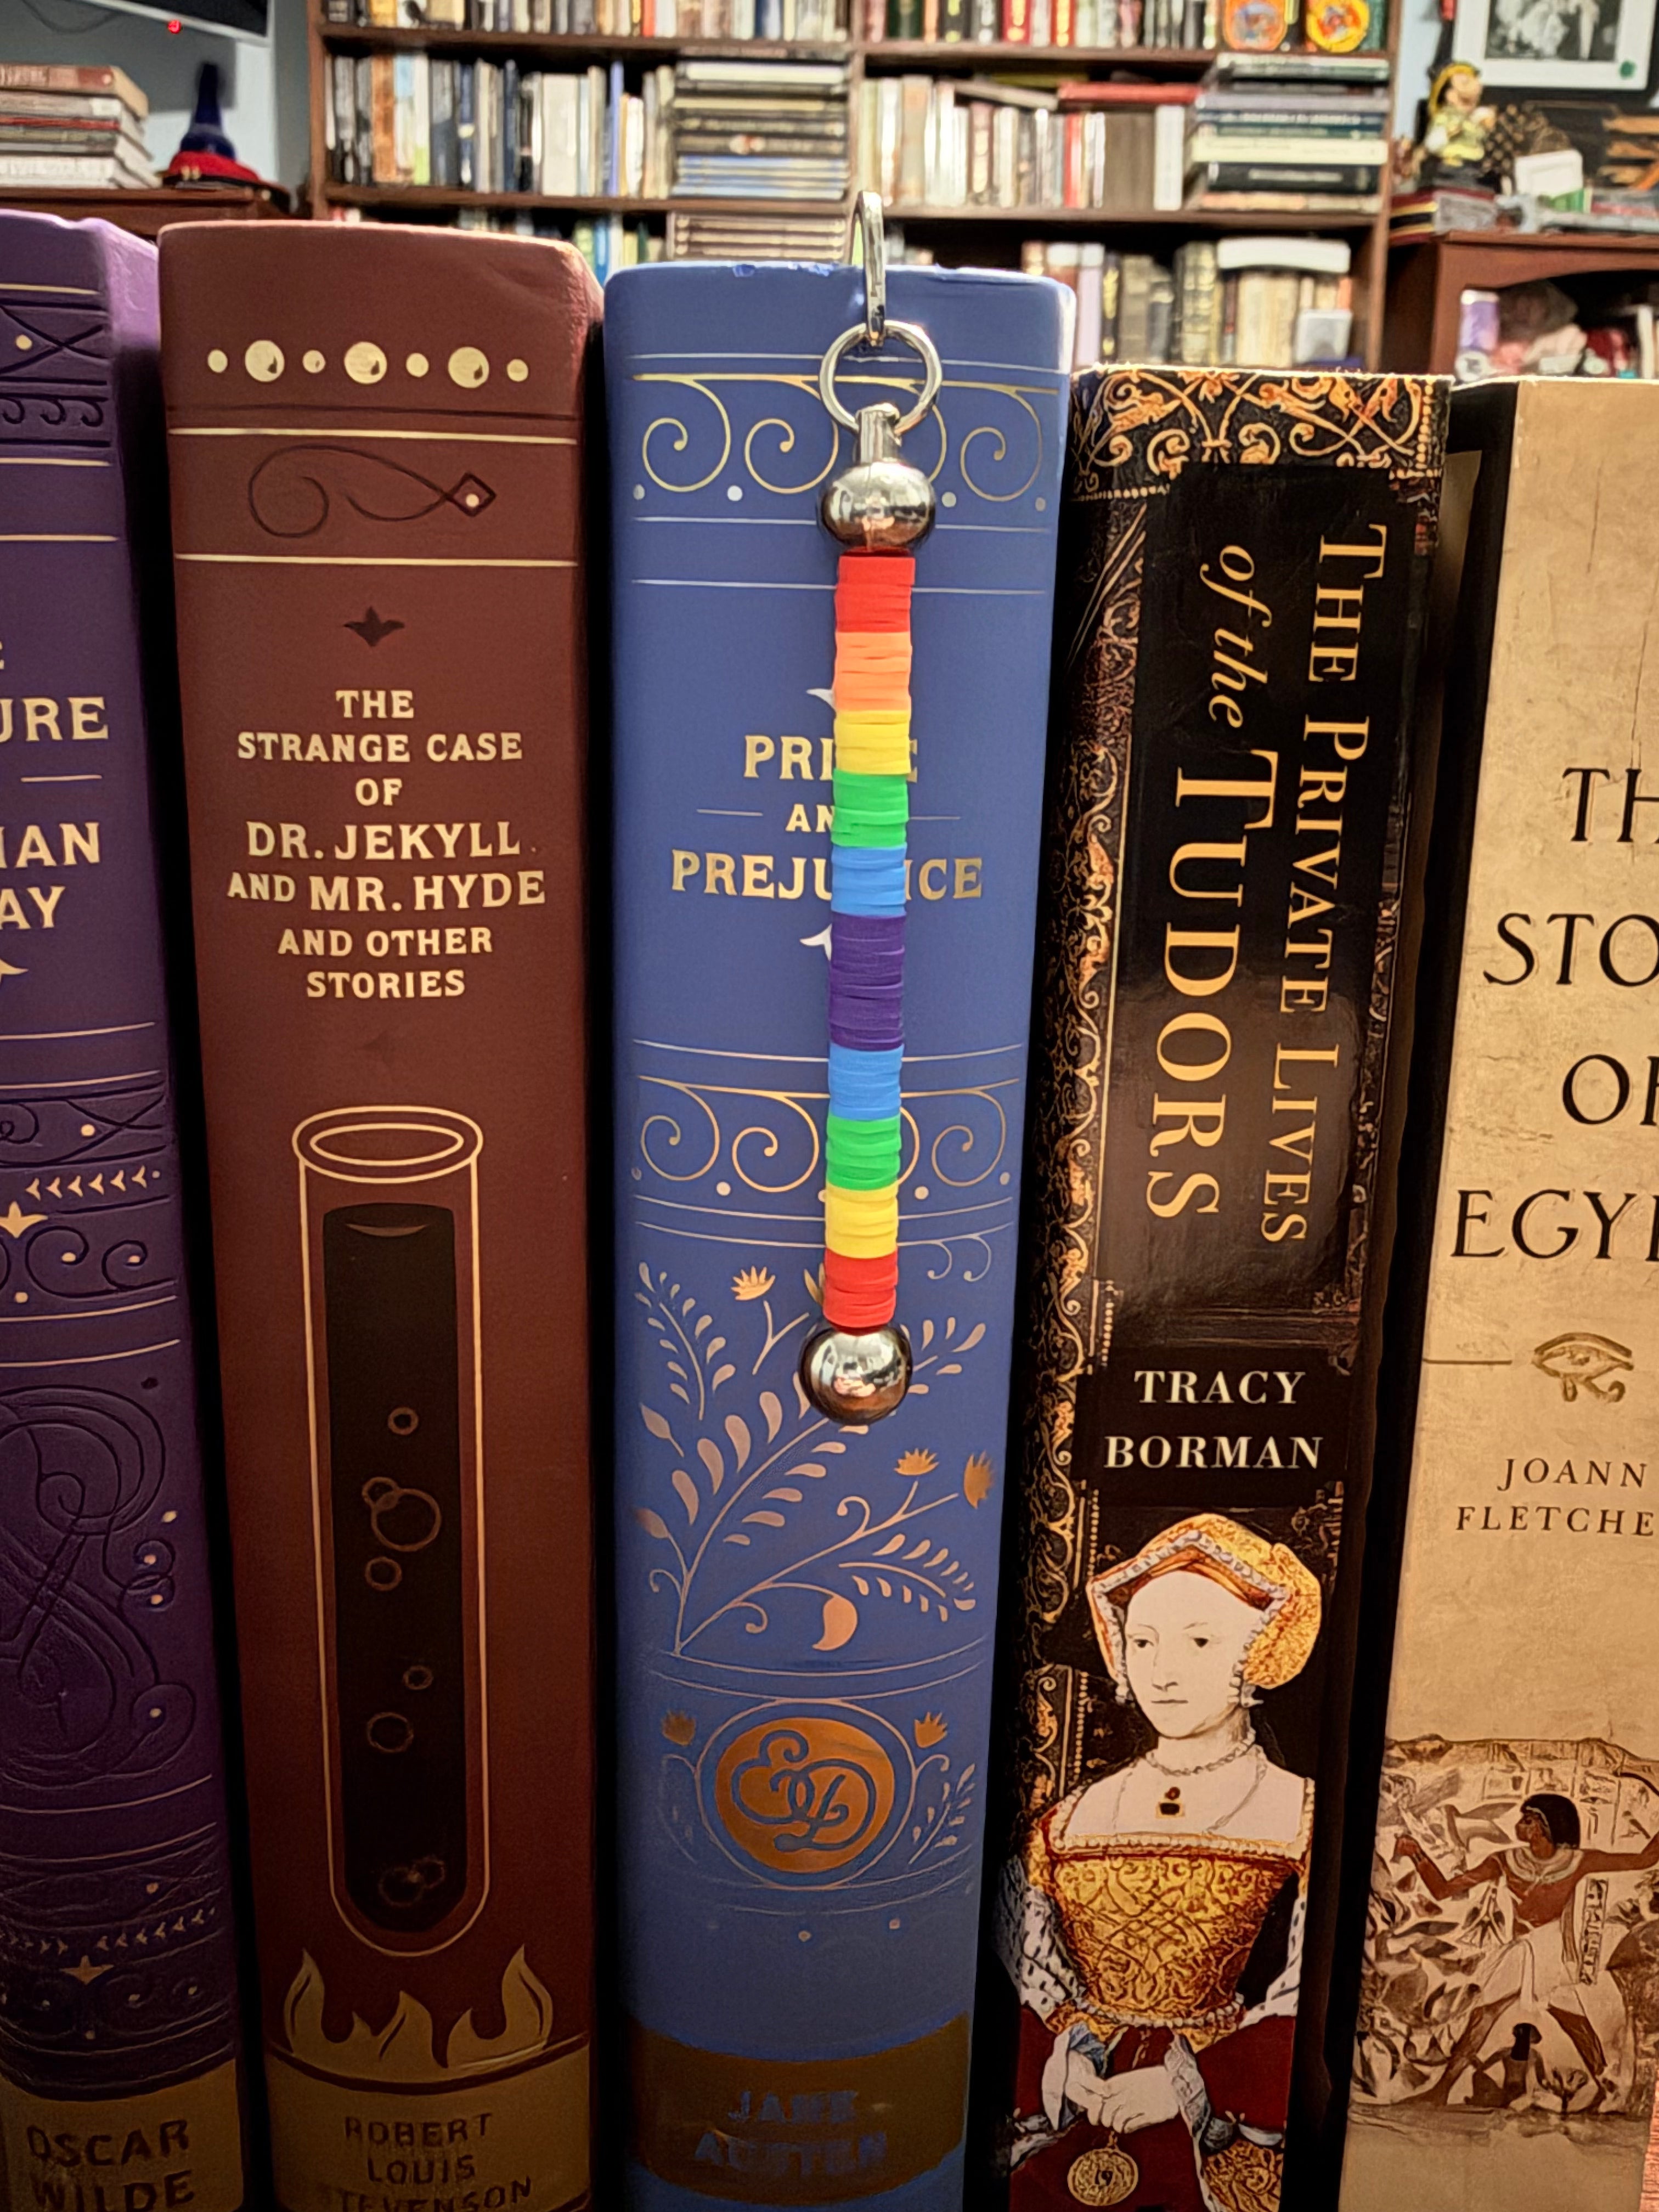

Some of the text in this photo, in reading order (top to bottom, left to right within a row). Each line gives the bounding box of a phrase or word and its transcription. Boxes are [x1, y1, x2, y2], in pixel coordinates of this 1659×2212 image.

[336, 690, 414, 718] THE
[238, 731, 522, 762] STRANGE CASE
[743, 735, 917, 783] PRI
[356, 778, 402, 806] OF
[785, 804, 835, 832] AN
[247, 821, 520, 860] DR. JEKYLL
[227, 871, 545, 911] AND MR. HYDE
[1147, 545, 1278, 1218] of the TUDORS
[1261, 523, 1387, 1243] THE PRIVATE LIVES
[278, 927, 492, 957] AND OTHER
[306, 969, 465, 998] STORIES
[1134, 1370, 1306, 1404] TRACY
[1103, 1436, 1323, 1469] BORMAN
[1497, 1458, 1647, 1491] JOANN
[1456, 1506, 1655, 1536] FLETCHE
[27, 2119, 189, 2167] OSCAR
[345, 2112, 492, 2146] ROBERT
[367, 2154, 475, 2185] LOUIS
[32, 2170, 195, 2212] WILDE
[318, 2176, 531, 2212] TEVENSON
